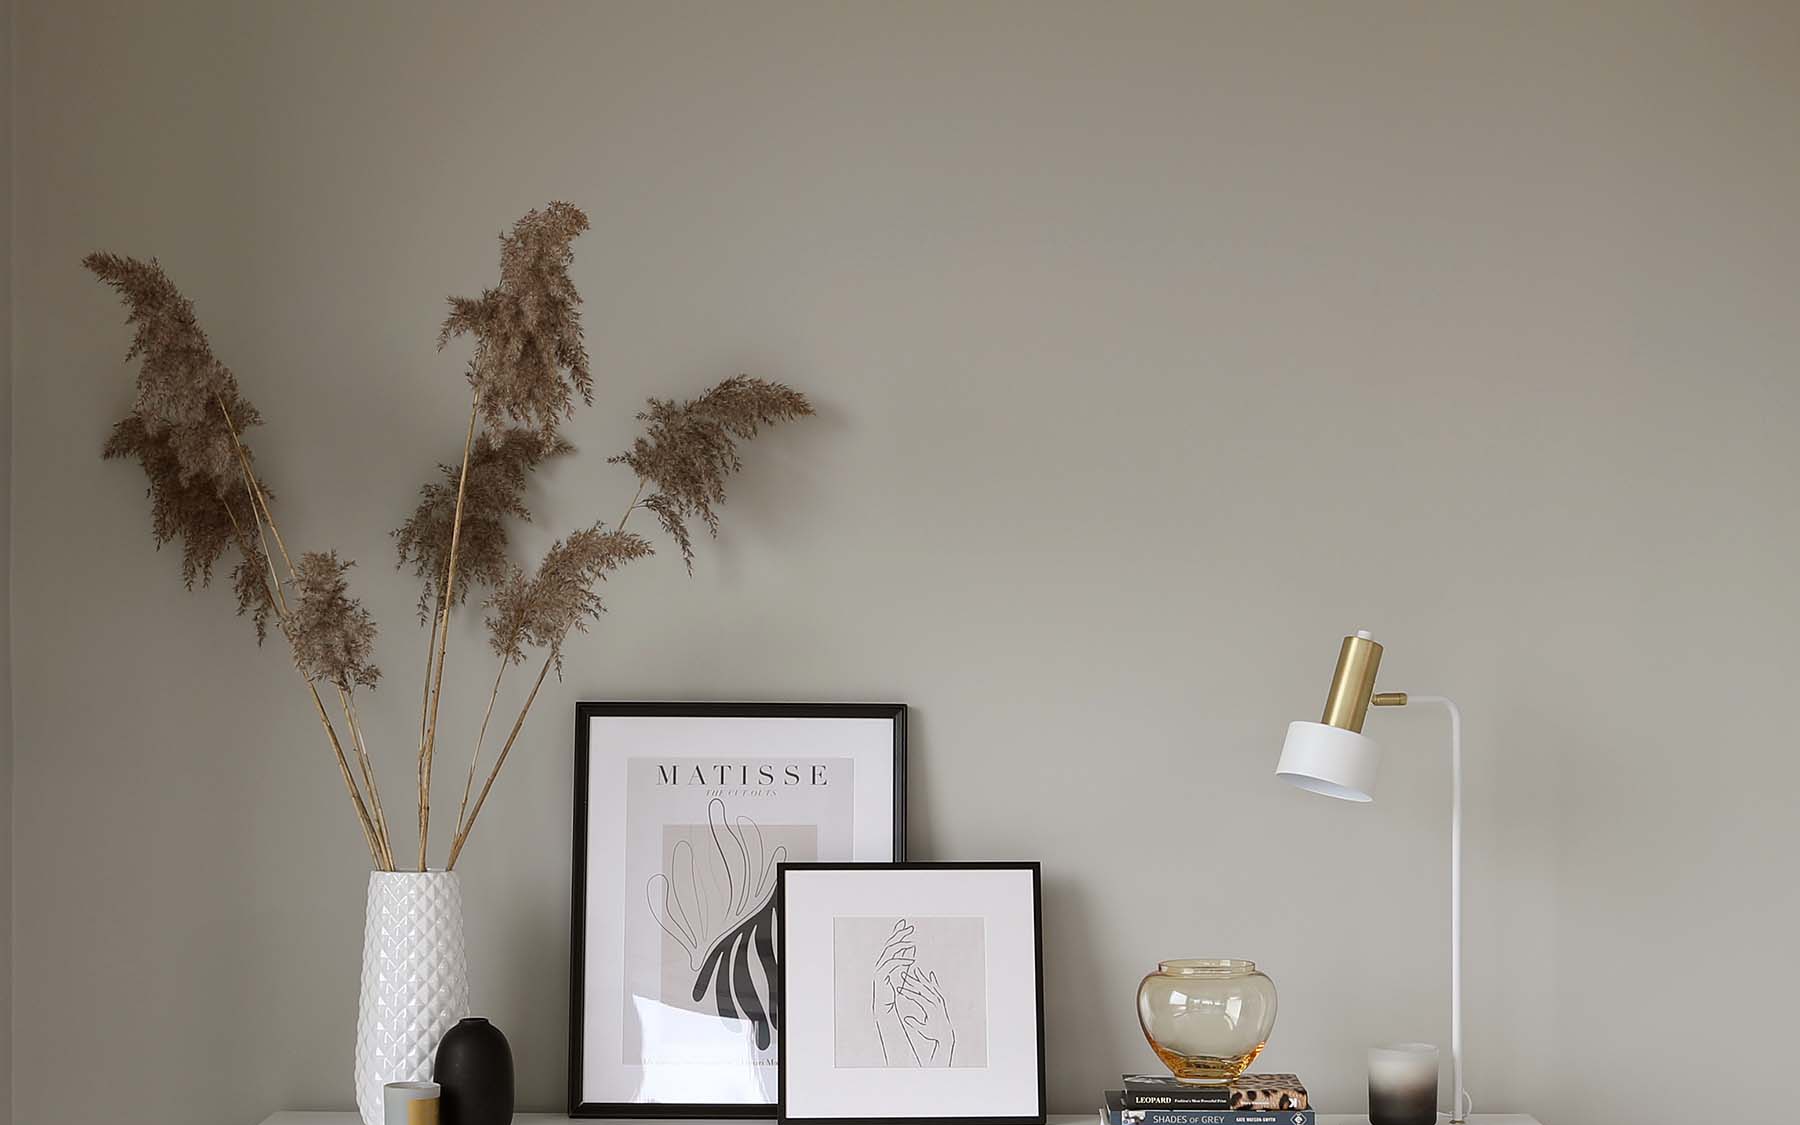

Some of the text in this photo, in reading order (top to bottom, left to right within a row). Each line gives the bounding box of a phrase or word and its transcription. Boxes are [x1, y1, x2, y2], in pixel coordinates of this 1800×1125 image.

[656, 765, 828, 786] MATISSE
[1135, 1096, 1172, 1104] LEOPARD
[1153, 1115, 1188, 1124] SHADES
[1201, 1115, 1225, 1124] GREY
